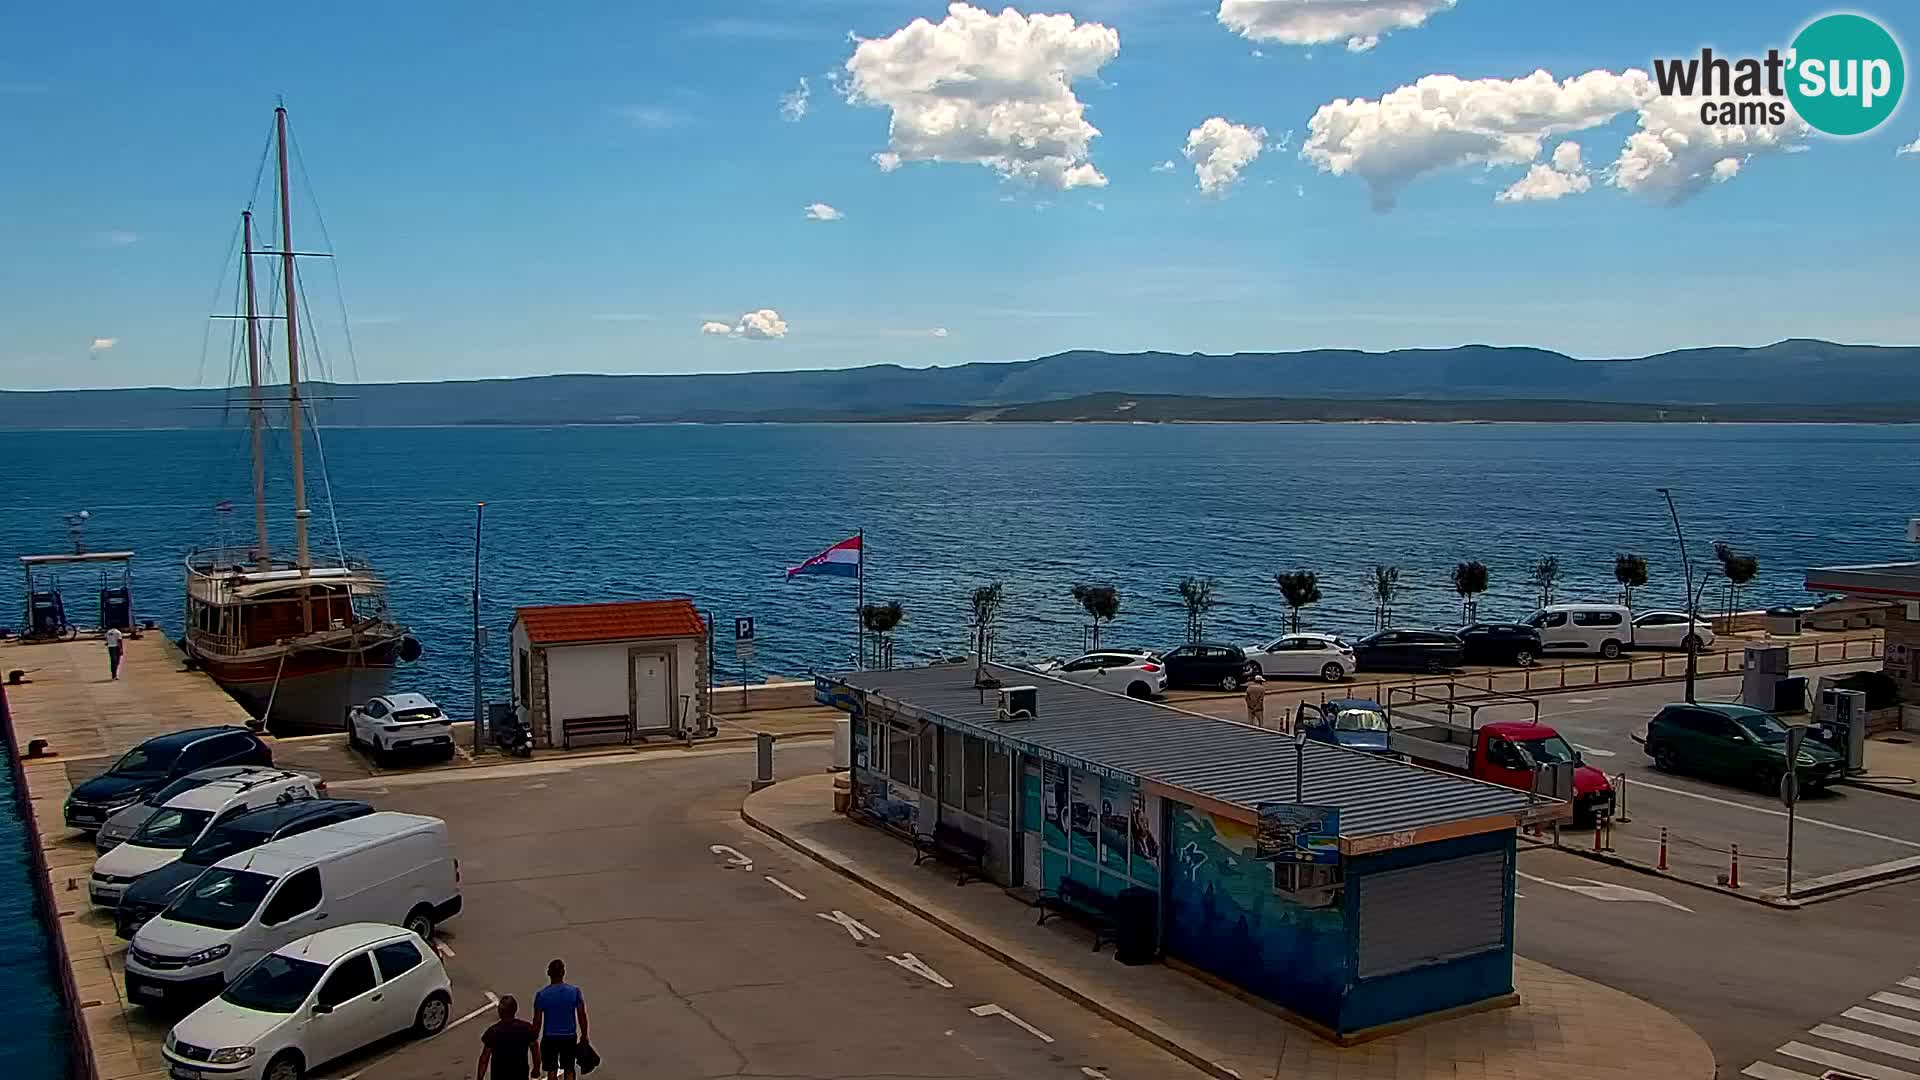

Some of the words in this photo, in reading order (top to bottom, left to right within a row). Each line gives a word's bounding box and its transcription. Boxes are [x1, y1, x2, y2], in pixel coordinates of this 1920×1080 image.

[739, 619, 750, 637] P
[1053, 752, 1083, 769] STATION
[1085, 762, 1110, 777] TICKET
[1111, 768, 1137, 785] OFFICE
